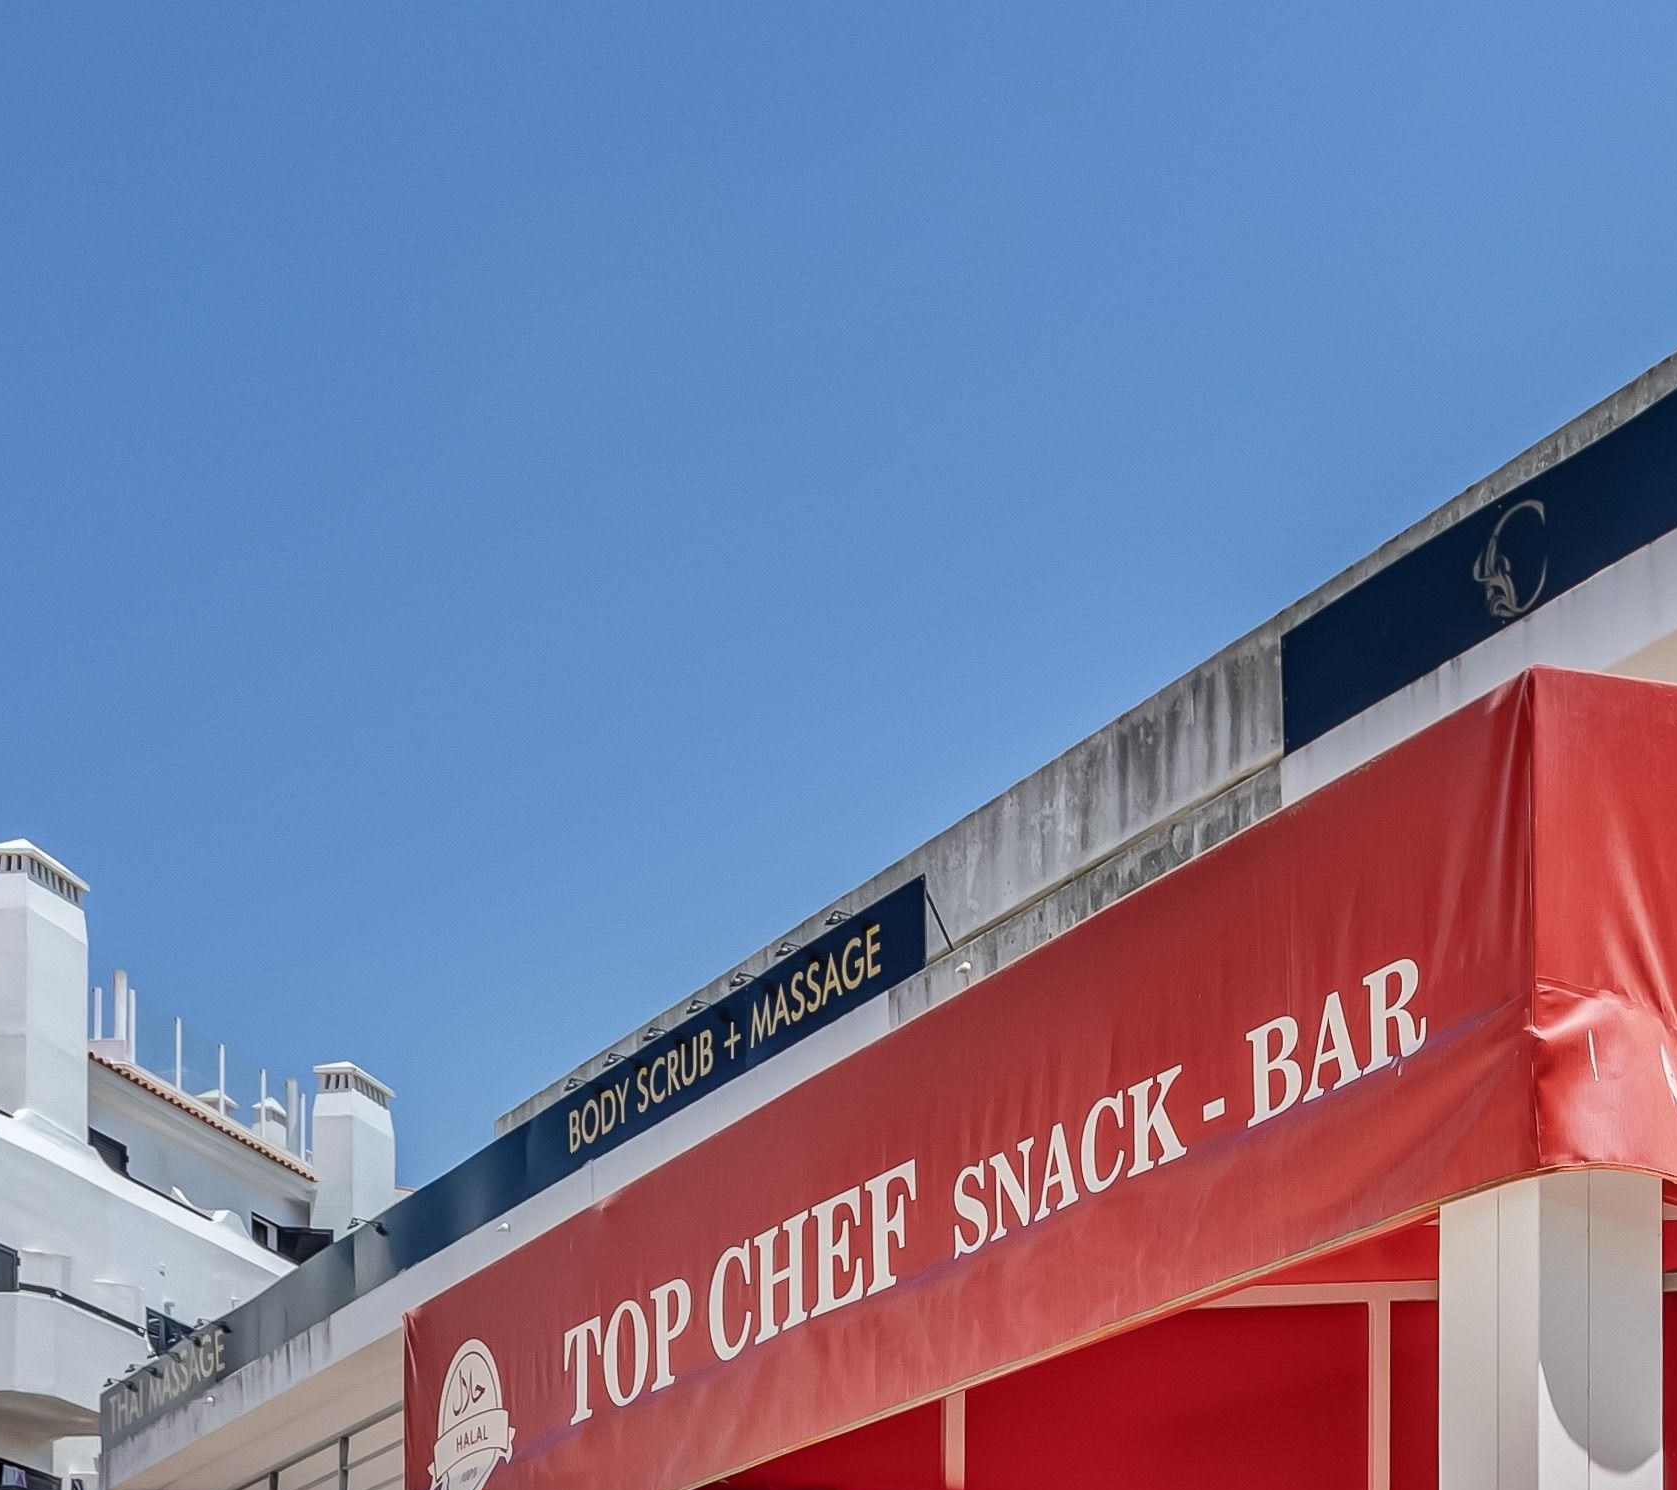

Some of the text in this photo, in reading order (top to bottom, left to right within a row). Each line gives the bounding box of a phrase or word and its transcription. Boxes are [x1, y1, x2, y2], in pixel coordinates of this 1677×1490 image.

[569, 924, 881, 1153] BODY SCRUB + MASSAGE
[563, 1276, 692, 1426] TOP
[708, 1159, 918, 1363] CHEF
[952, 1064, 1186, 1259] SNACK
[1245, 957, 1426, 1128] BAR
[109, 1330, 225, 1434] THAI MASSAGE
[456, 1425, 489, 1453] HALAL
